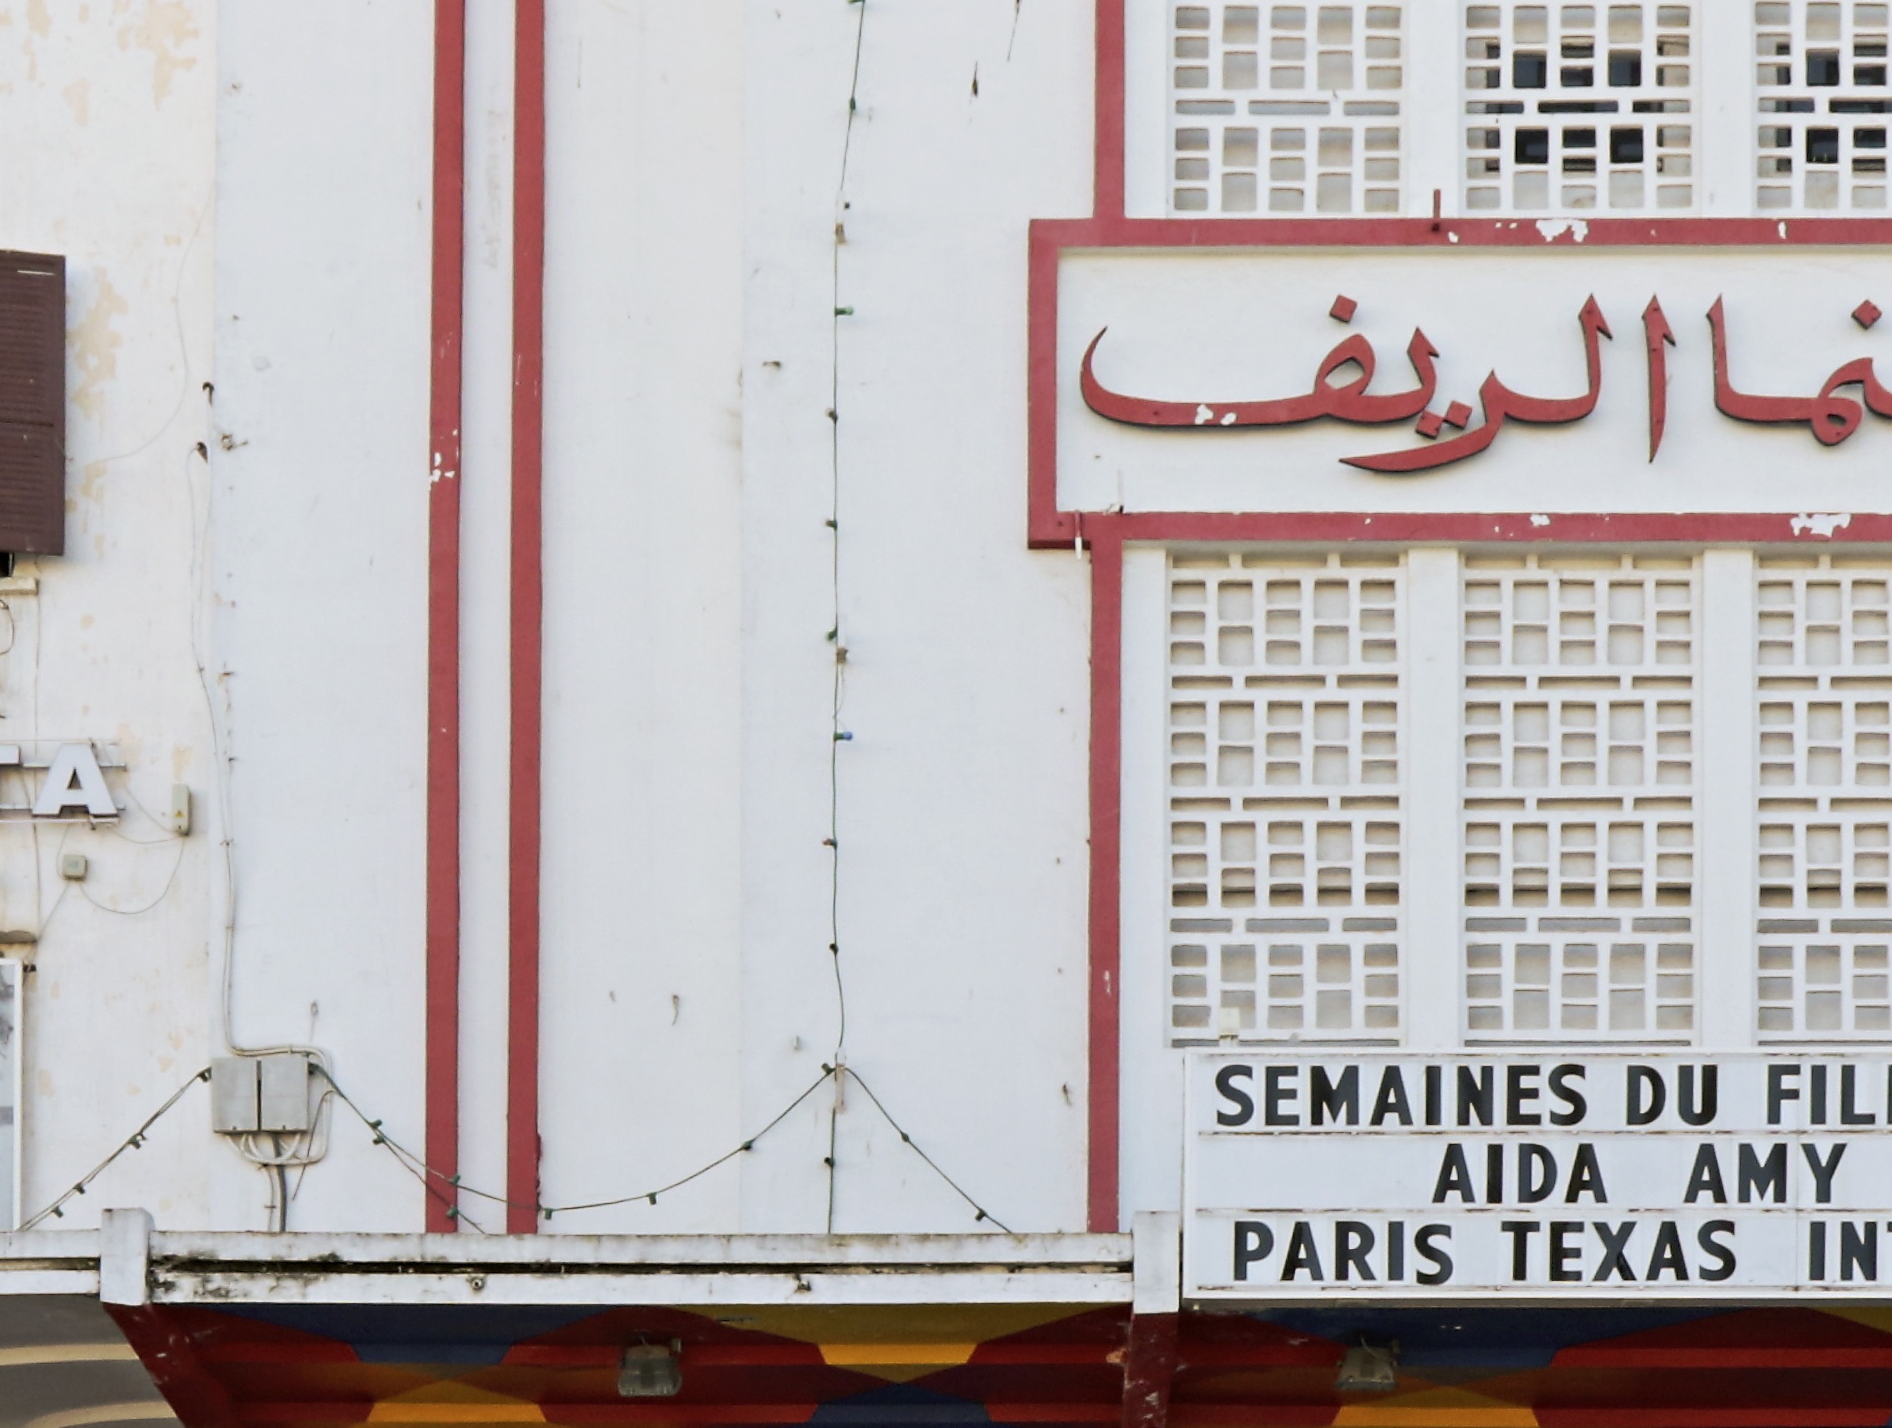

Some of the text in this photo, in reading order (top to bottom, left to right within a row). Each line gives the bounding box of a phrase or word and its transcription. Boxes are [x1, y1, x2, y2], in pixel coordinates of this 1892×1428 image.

[1079, 293, 1673, 473] الريف
[1213, 1062, 1587, 1128] SEMAINES
[1626, 1062, 1718, 1127] DU
[1431, 1141, 1608, 1204] AIDA
[1683, 1141, 1846, 1204] AMY
[1233, 1219, 1454, 1286] PARIS
[1500, 1217, 1737, 1283] TEXAS
